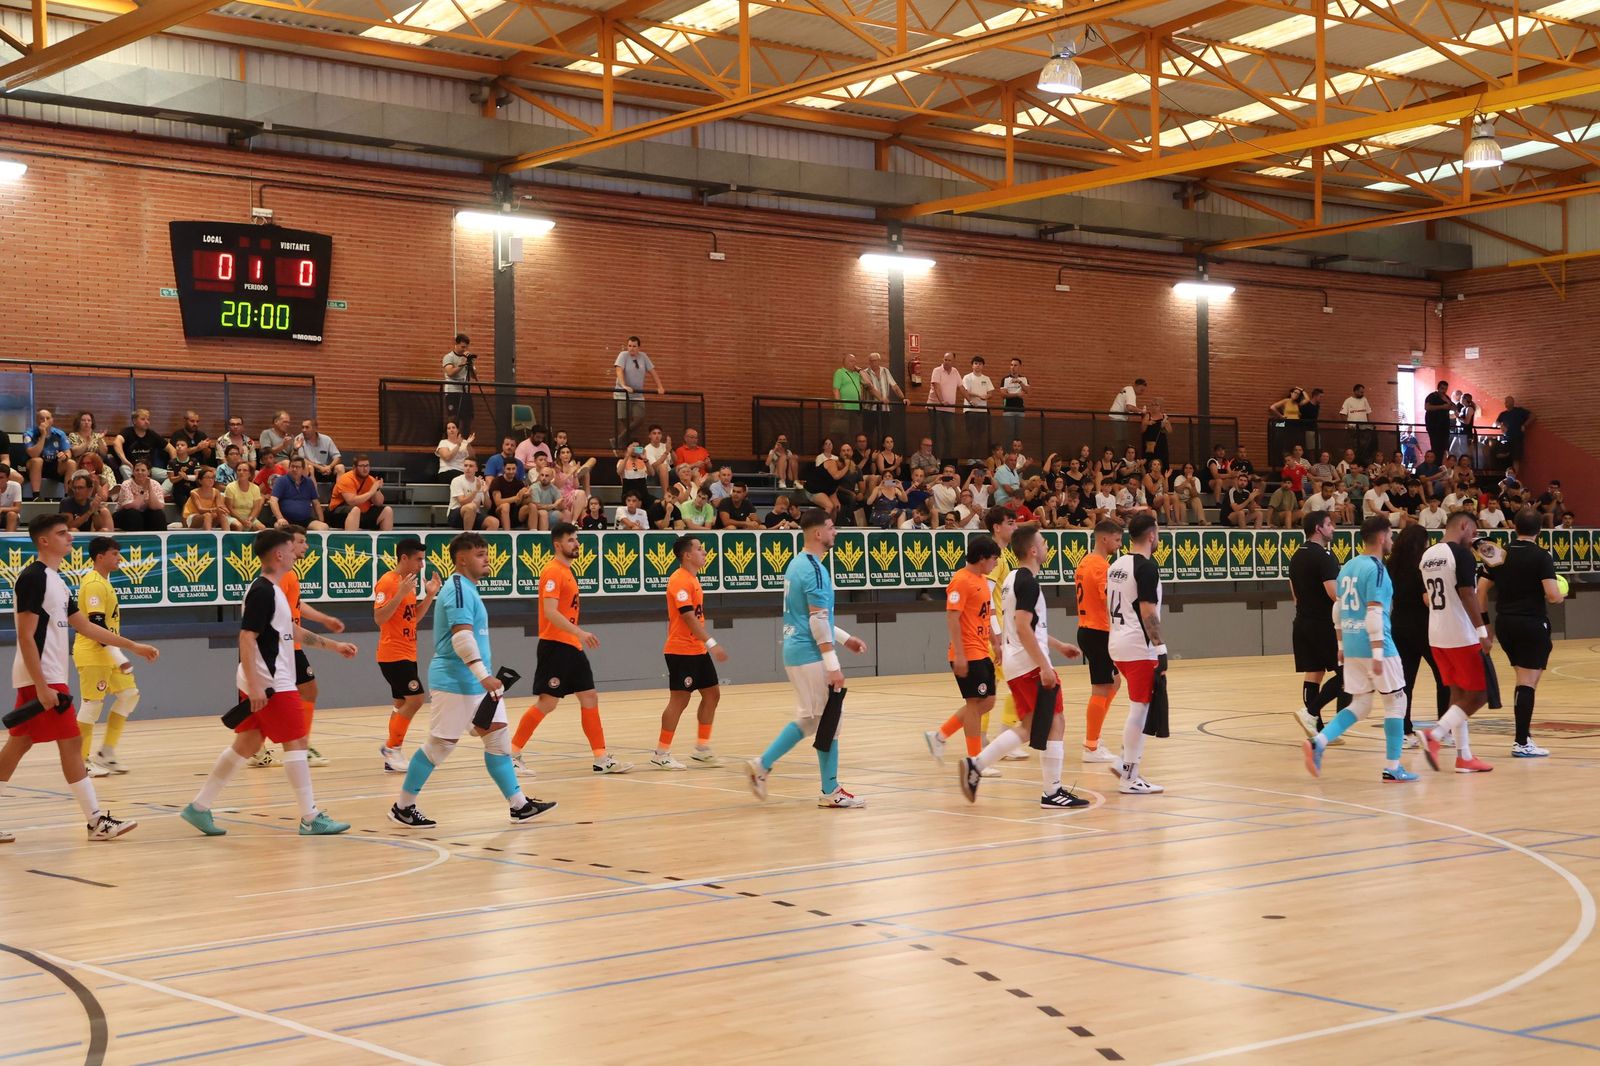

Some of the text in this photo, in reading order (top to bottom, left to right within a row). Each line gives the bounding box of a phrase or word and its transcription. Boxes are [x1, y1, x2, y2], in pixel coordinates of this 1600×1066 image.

[203, 235, 222, 244] LOCAL
[280, 242, 310, 252] VISITANTE
[218, 254, 232, 280] 0
[256, 260, 262, 279] 1
[300, 260, 314, 286] 0
[244, 283, 269, 291] PERIODO
[221, 300, 290, 330] 20:00
[1342, 576, 1358, 610] 25
[1427, 578, 1446, 610] 23
